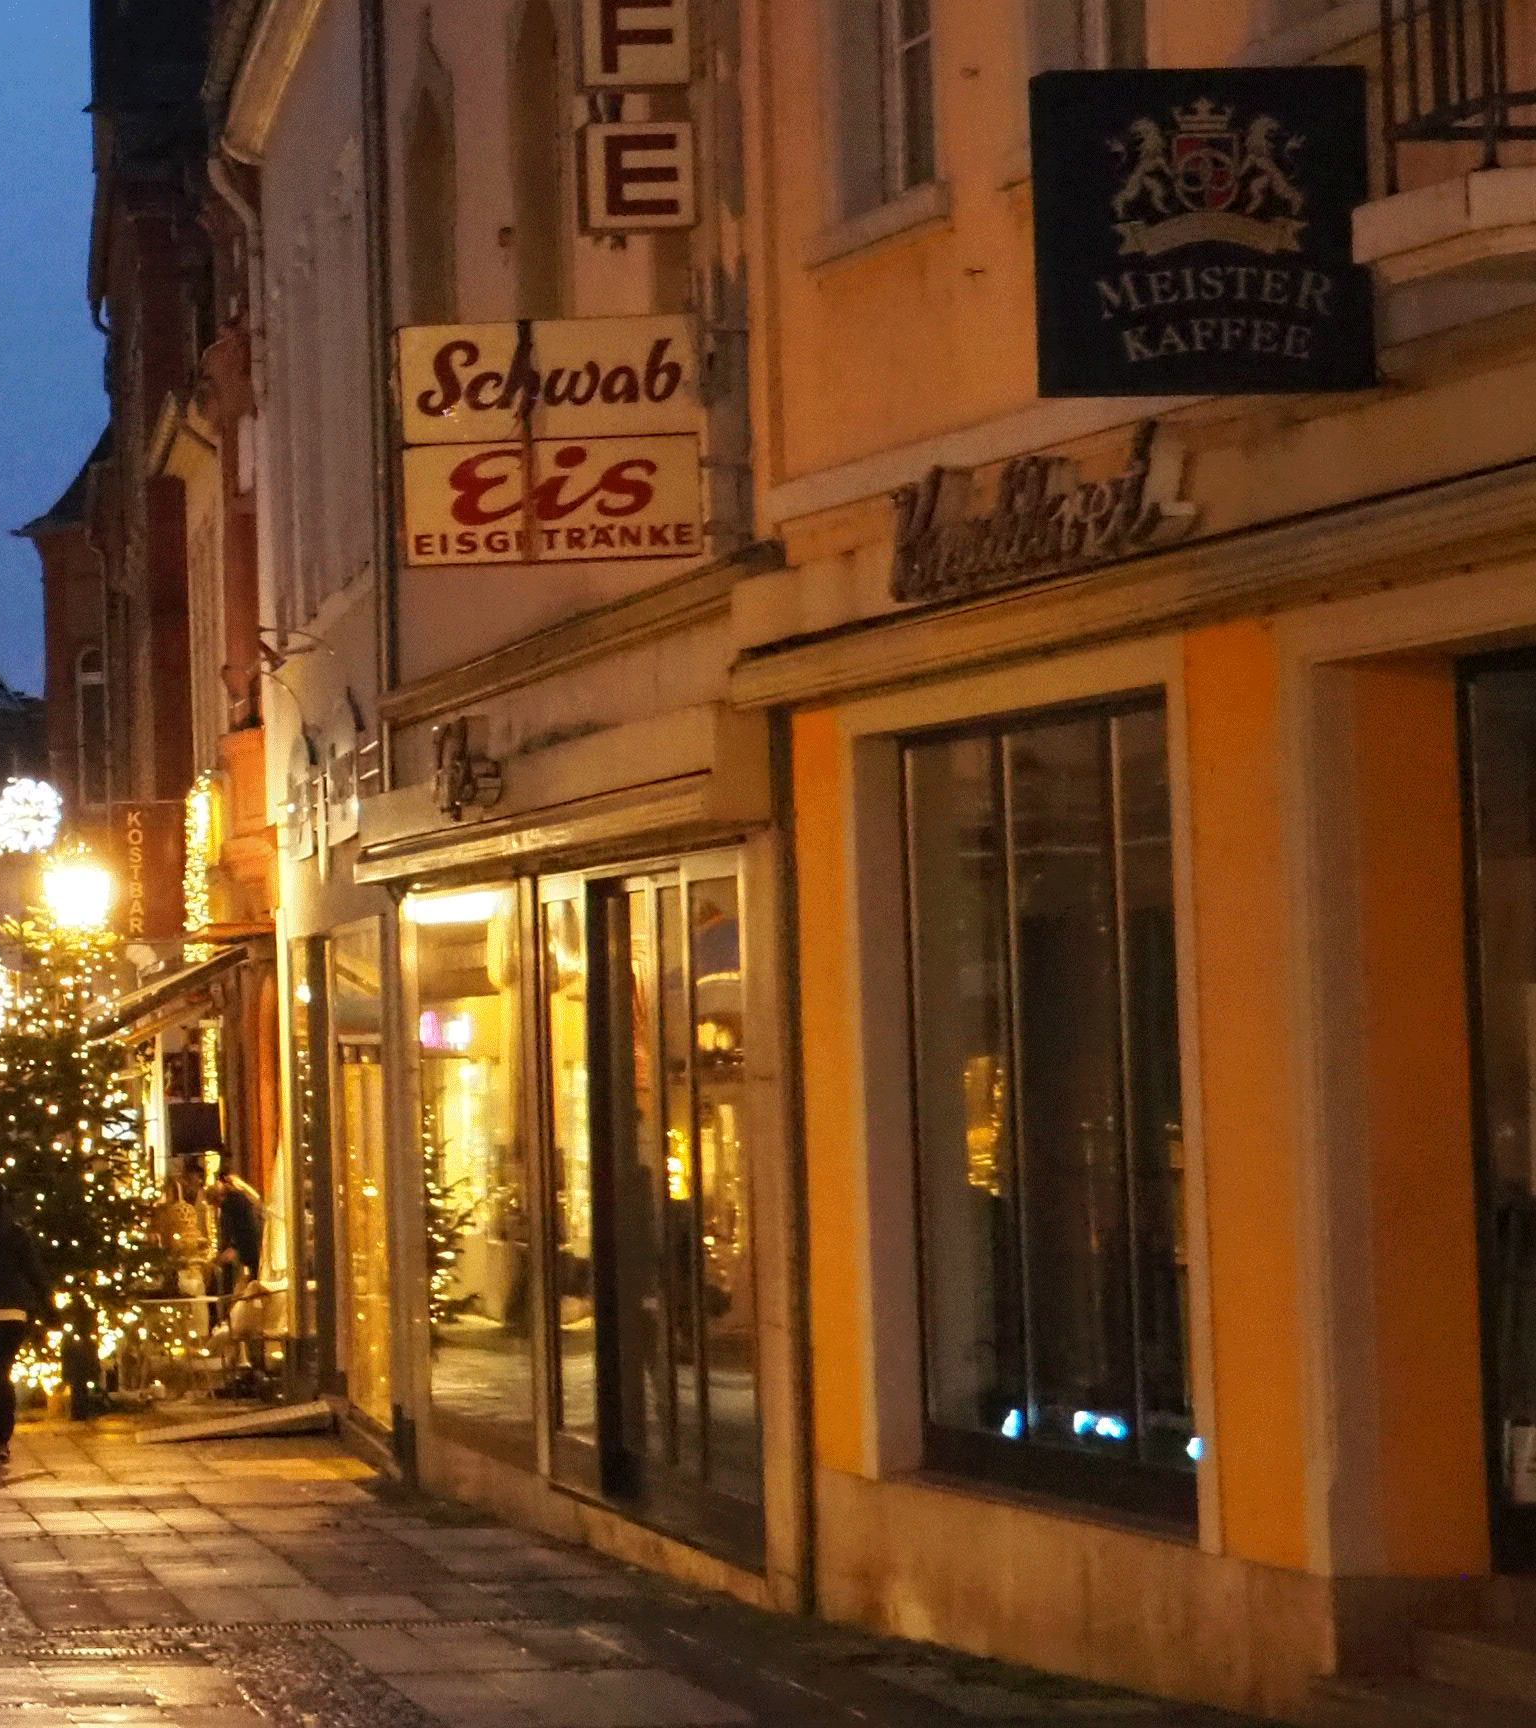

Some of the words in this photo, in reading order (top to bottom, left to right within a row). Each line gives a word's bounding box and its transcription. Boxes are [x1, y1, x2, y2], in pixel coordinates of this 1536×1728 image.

[1095, 266, 1332, 319] MEISTER
[1123, 317, 1311, 363] KAFFEE
[416, 338, 682, 417] Schwab
[448, 446, 657, 527] Eis
[413, 522, 696, 556] EISGTRÄNKE
[127, 810, 145, 934] KOSTBAR
